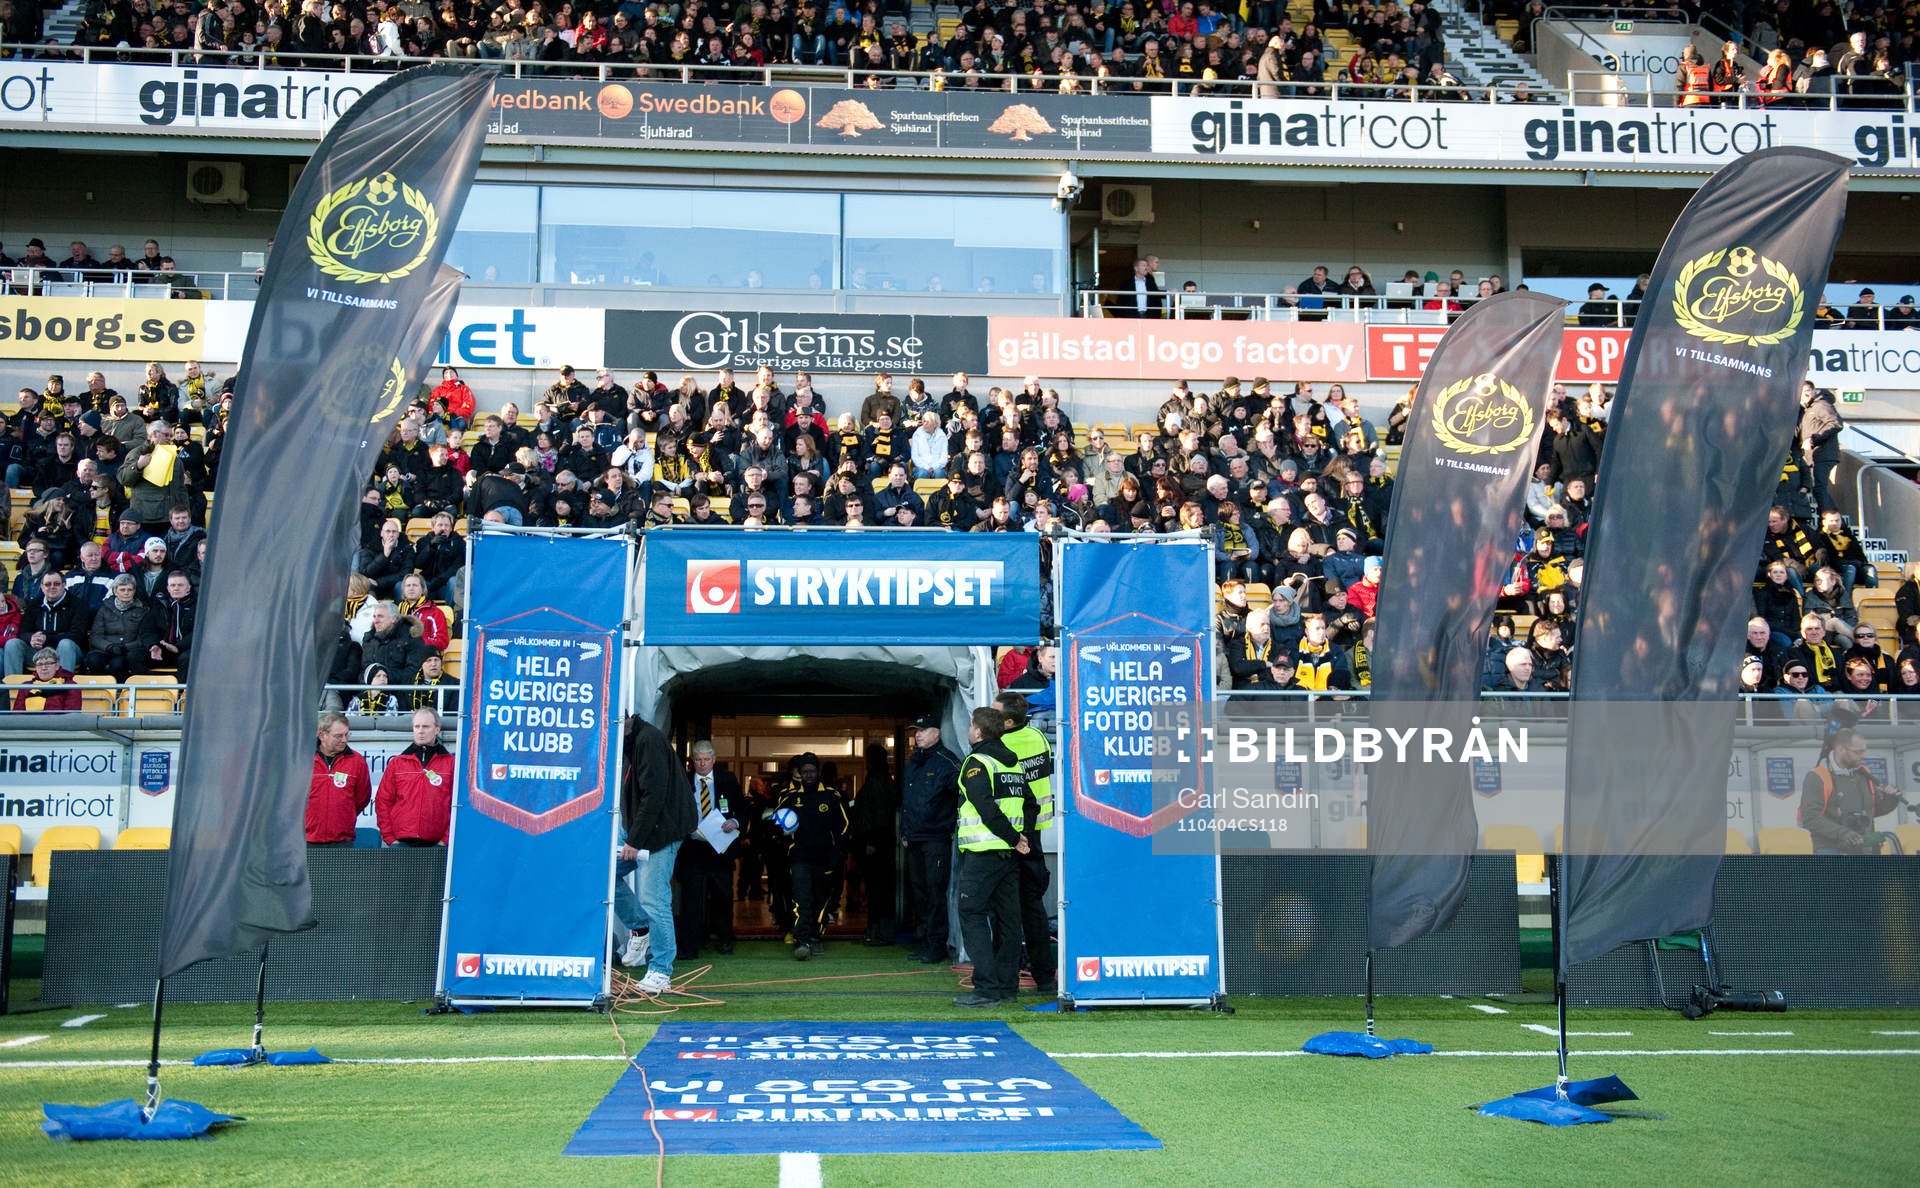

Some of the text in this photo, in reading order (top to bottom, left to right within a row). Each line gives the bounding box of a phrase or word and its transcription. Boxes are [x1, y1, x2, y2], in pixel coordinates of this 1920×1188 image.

[639, 92, 765, 116] Swedbank
[890, 110, 979, 123] Sparbanksstiftelsen
[1061, 114, 1149, 127] Sparbanksstiftelsen
[640, 124, 693, 139] Sjuhärad
[890, 123, 932, 134] Sjuhärad
[1061, 127, 1101, 138] Sjuhärad
[1190, 100, 1448, 154] ginatricot
[1523, 108, 1777, 161] ginatricot
[327, 205, 423, 259] Elfsborg
[306, 288, 398, 310] VI TILLSAMMANS
[1690, 276, 1787, 323] Elfsborg
[670, 311, 924, 369] Carlsteins.se
[998, 331, 1354, 371] gällstad logo factory
[734, 354, 923, 372] Sveriges klädgrossist
[1675, 347, 1686, 357] VI
[1690, 349, 1773, 378] TILLSAMMANS
[1446, 396, 1519, 438] Elfsborg
[1435, 457, 1511, 476] VI TILLSAMMANS
[754, 566, 998, 606] STRYKTIPSET
[514, 636, 560, 647] VÄLKOMMEN
[563, 639, 571, 647] IN
[1105, 642, 1151, 651] VÄLKOMMEN
[1153, 643, 1161, 651] IN
[515, 656, 570, 677] HELA
[1110, 661, 1163, 681] HELA
[489, 680, 594, 704] SVERIGES
[1086, 686, 1187, 706] SVERIGES
[485, 705, 595, 729] FOTBOLLS
[1084, 711, 1190, 731] FOTBOLLS
[503, 731, 573, 753] KLUBB
[1104, 736, 1171, 757] KLUBB
[510, 767, 580, 780] STRYKTIPSET
[1113, 771, 1180, 783] STRYKTIPSET
[485, 958, 591, 978] STRYKTIPSET
[1105, 959, 1206, 977] STRYKTIPSET
